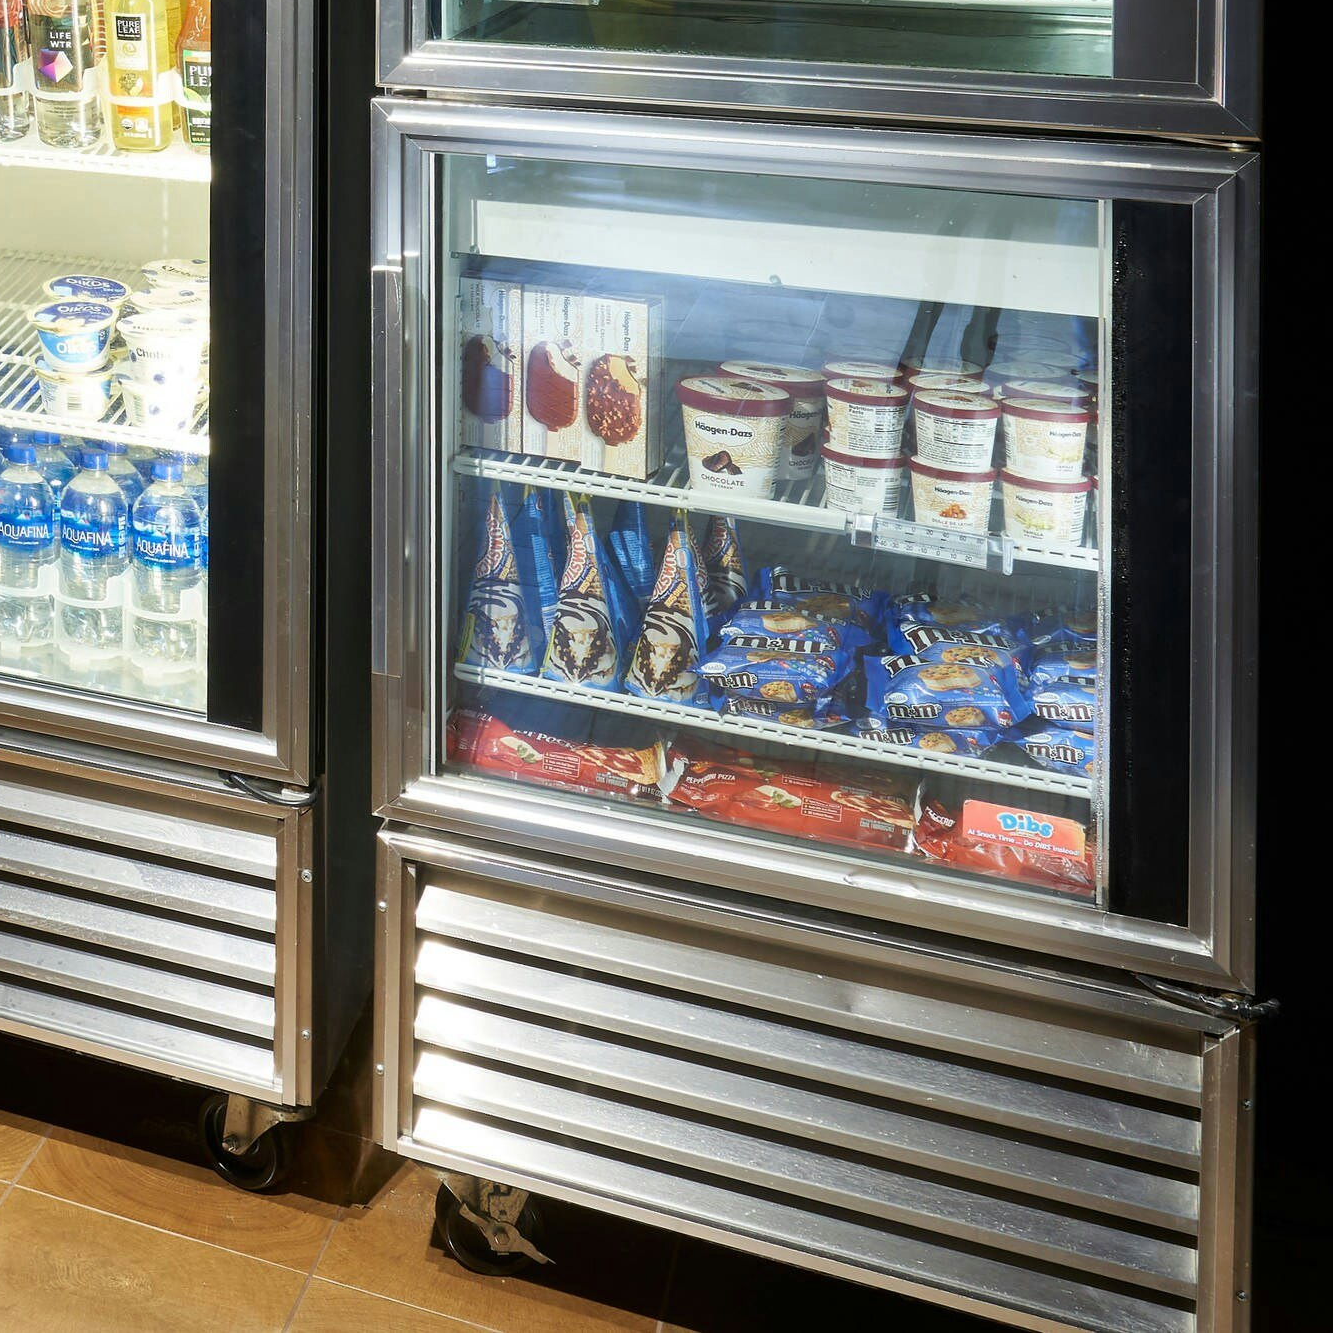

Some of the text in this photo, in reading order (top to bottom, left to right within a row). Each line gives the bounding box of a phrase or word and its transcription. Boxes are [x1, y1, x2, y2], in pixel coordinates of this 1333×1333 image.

[117, 18, 140, 27] PURE
[117, 26, 140, 34] LEAF
[49, 31, 72, 41] LIFE
[49, 40, 72, 49] WTR
[695, 420, 753, 440] Häagen-Dazs
[700, 472, 745, 487] CHOCOLATE
[61, 523, 113, 546] AQUAFINA
[136, 536, 190, 558] AQUAFINA
[950, 552, 957, 560] 10
[703, 671, 758, 689] m&m's
[887, 702, 942, 720] m&m's
[1035, 702, 1095, 722] m&m's
[860, 726, 915, 745] m&m's
[1026, 742, 1085, 764] m&m's
[685, 771, 736, 783] PEPPERONI PIZZA
[996, 811, 1054, 839] Dibs
[977, 831, 997, 840] Snack
[998, 834, 1015, 844] Time
[1024, 839, 1033, 847] Do
